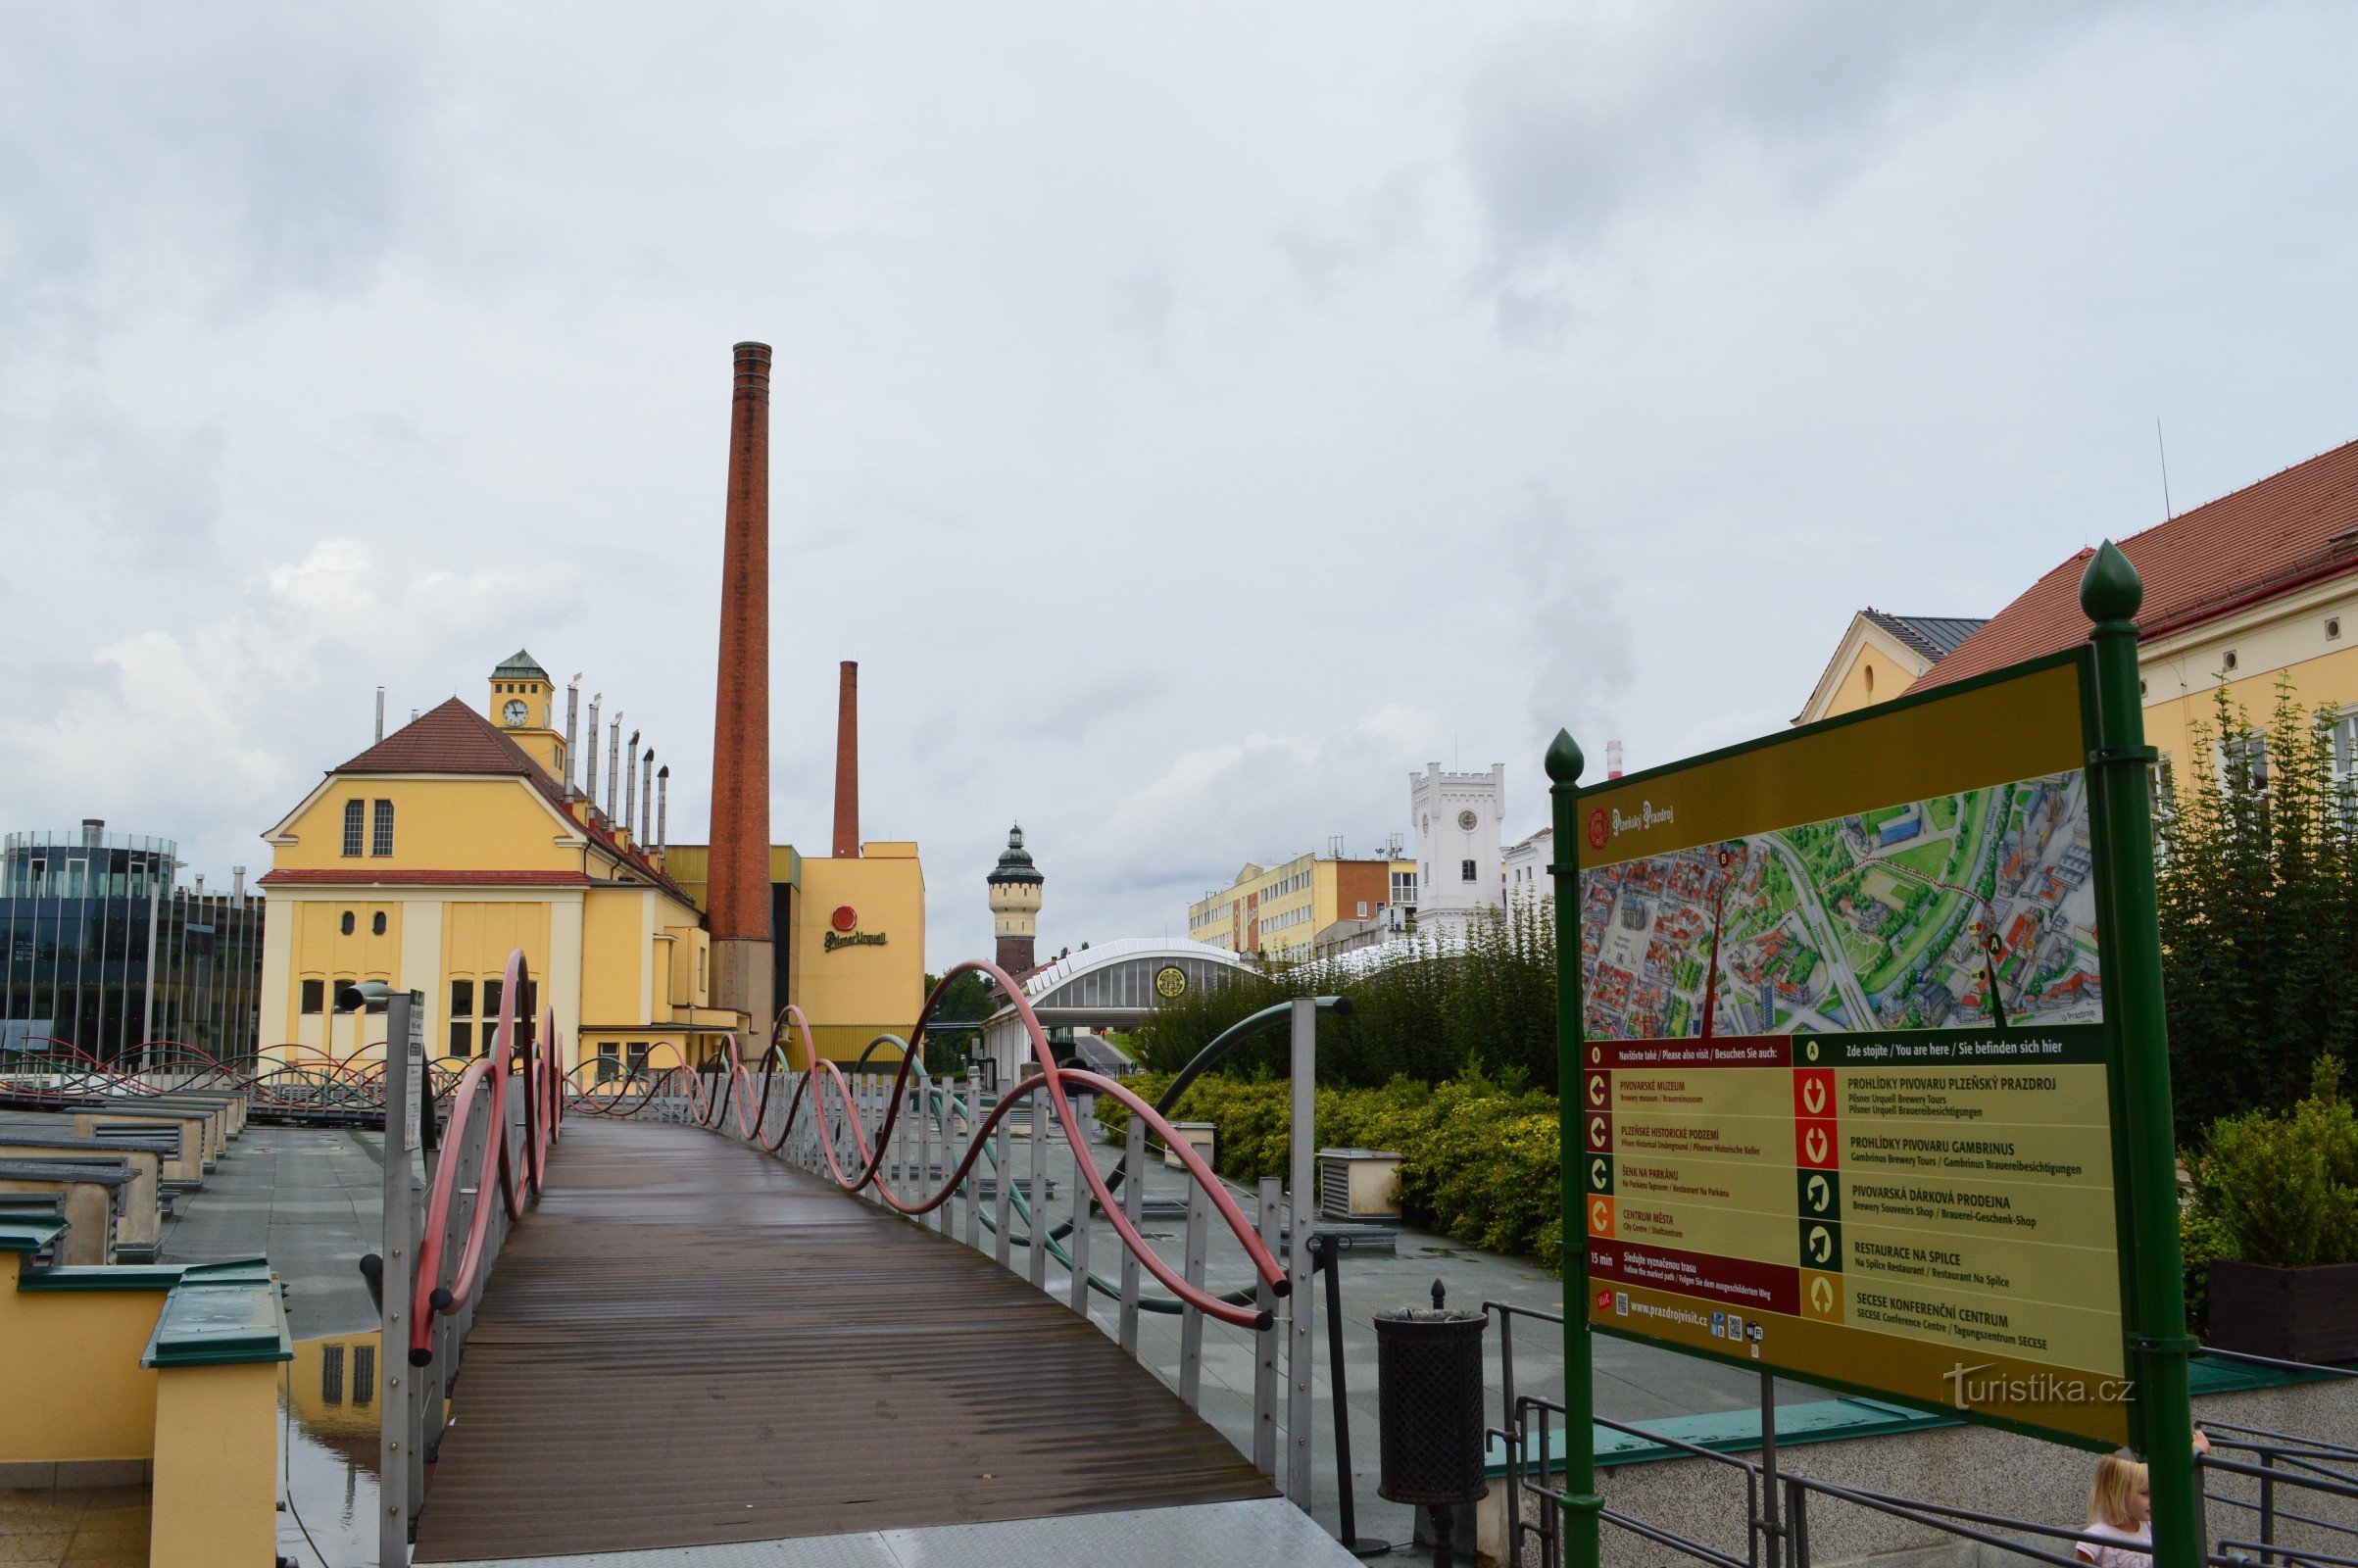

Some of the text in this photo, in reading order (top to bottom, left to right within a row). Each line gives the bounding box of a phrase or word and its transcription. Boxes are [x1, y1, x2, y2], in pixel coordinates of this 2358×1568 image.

[1612, 808, 1643, 837] Plzeňský
[1644, 801, 1674, 830] Prazdroj
[1721, 853, 1727, 864] B
[825, 930, 887, 953] Pilsner Urquell
[1990, 937, 1999, 949] A
[1645, 1051, 1656, 1059] také
[1663, 1050, 1681, 1059] Please
[1683, 1050, 1695, 1059] also
[1696, 1049, 1708, 1058] visit
[1715, 1049, 1744, 1058] Besuchen
[1747, 1048, 1756, 1057] Sie
[1759, 1047, 1777, 1057] auch:
[1810, 1046, 1815, 1055] A
[1846, 1045, 1860, 1056] Zde
[1896, 1044, 1911, 1055] You
[1914, 1046, 1927, 1055] are
[1930, 1044, 1949, 1054] here
[1959, 1042, 1973, 1054] Sie
[1976, 1041, 2017, 1054] befinden
[2020, 1041, 2039, 1054] sich
[2042, 1040, 2062, 1053] hier
[1620, 1080, 1685, 1091] PIVOVARSKÉ MUZEUM
[1848, 1075, 2056, 1091] PROHLÍDKY PIVOVARU PLZEŇSKÝ PRAZDROJ
[1621, 1095, 1638, 1103] Brewery
[1663, 1095, 1703, 1103] Brauereimuseum
[1848, 1094, 1946, 1106] Pilsner Urquell Brewery Tours
[1849, 1105, 1982, 1118] Pilsner Urquell Brauereibesichtigungen
[1622, 1125, 1719, 1140] PLZEŇSKÉ HISTORICKÉ PODZEMÍ
[1636, 1140, 1656, 1149] Historical
[1658, 1142, 1688, 1152] Underground
[1715, 1145, 1743, 1154] Historische
[1744, 1147, 1760, 1155] Keller
[1850, 1136, 2014, 1155] PROHLÍDKY PIVOVARU GAMBRINUS
[1622, 1164, 1678, 1180] ŠENK NA PARKÁNU
[1851, 1152, 1886, 1163] Gambrinus
[1889, 1154, 1915, 1166] Brewery
[1918, 1156, 1936, 1165] Tours
[1944, 1157, 1984, 1168] Gambrinus
[1987, 1159, 2082, 1176] Brauereibesichtigungen
[1648, 1183, 1668, 1192] Taproom
[1673, 1186, 1699, 1195] Restaurant
[1708, 1189, 1729, 1198] Parkánu
[1853, 1185, 2010, 1209] PIVOVARSKÁ DÁRKOVÁ PRODEJNA
[1623, 1209, 1673, 1225] CENTRUM MĚSTA
[1853, 1201, 1879, 1213] Brewery
[1882, 1204, 1914, 1216] Souvenirs
[1916, 1206, 1934, 1219] Shop
[1941, 1208, 2036, 1228] Brauerei-Geschenk-Shop
[1623, 1223, 1632, 1233] City
[1633, 1224, 1646, 1234] Centre
[1652, 1226, 1683, 1238] Stadtzentrum
[1592, 1252, 1612, 1266] 15 min
[1855, 1242, 1960, 1266] RESTAURACE NA SPILCE
[1624, 1252, 1696, 1273] Sledujte vyznačenou trasu
[1855, 1258, 1864, 1267] Na
[1866, 1259, 1886, 1271] Spilce
[1888, 1261, 1925, 1275] Restaurant
[1933, 1268, 1972, 1282] Restaurant
[1974, 1274, 1984, 1284] Na
[1987, 1275, 2010, 1288] Spilce
[1624, 1265, 1638, 1275] Follow
[1646, 1269, 1663, 1279] marked
[1664, 1272, 1675, 1282] path
[1679, 1275, 1695, 1287] Folgen
[1704, 1279, 1714, 1288] dem
[1716, 1281, 1757, 1296] ausgeschilderten
[1759, 1288, 1771, 1300] Weg
[1631, 1301, 1707, 1326] www.prazdrojvisit.cz
[1857, 1293, 2008, 1328] SECESE KONFERENČNÍ CENTRUM
[1857, 1309, 1881, 1321] SECESE
[1883, 1313, 1921, 1328] Conference
[1924, 1319, 1946, 1332] Centre
[1954, 1325, 2015, 1345] Tagungszentrum
[2018, 1336, 2047, 1350] SECESE
